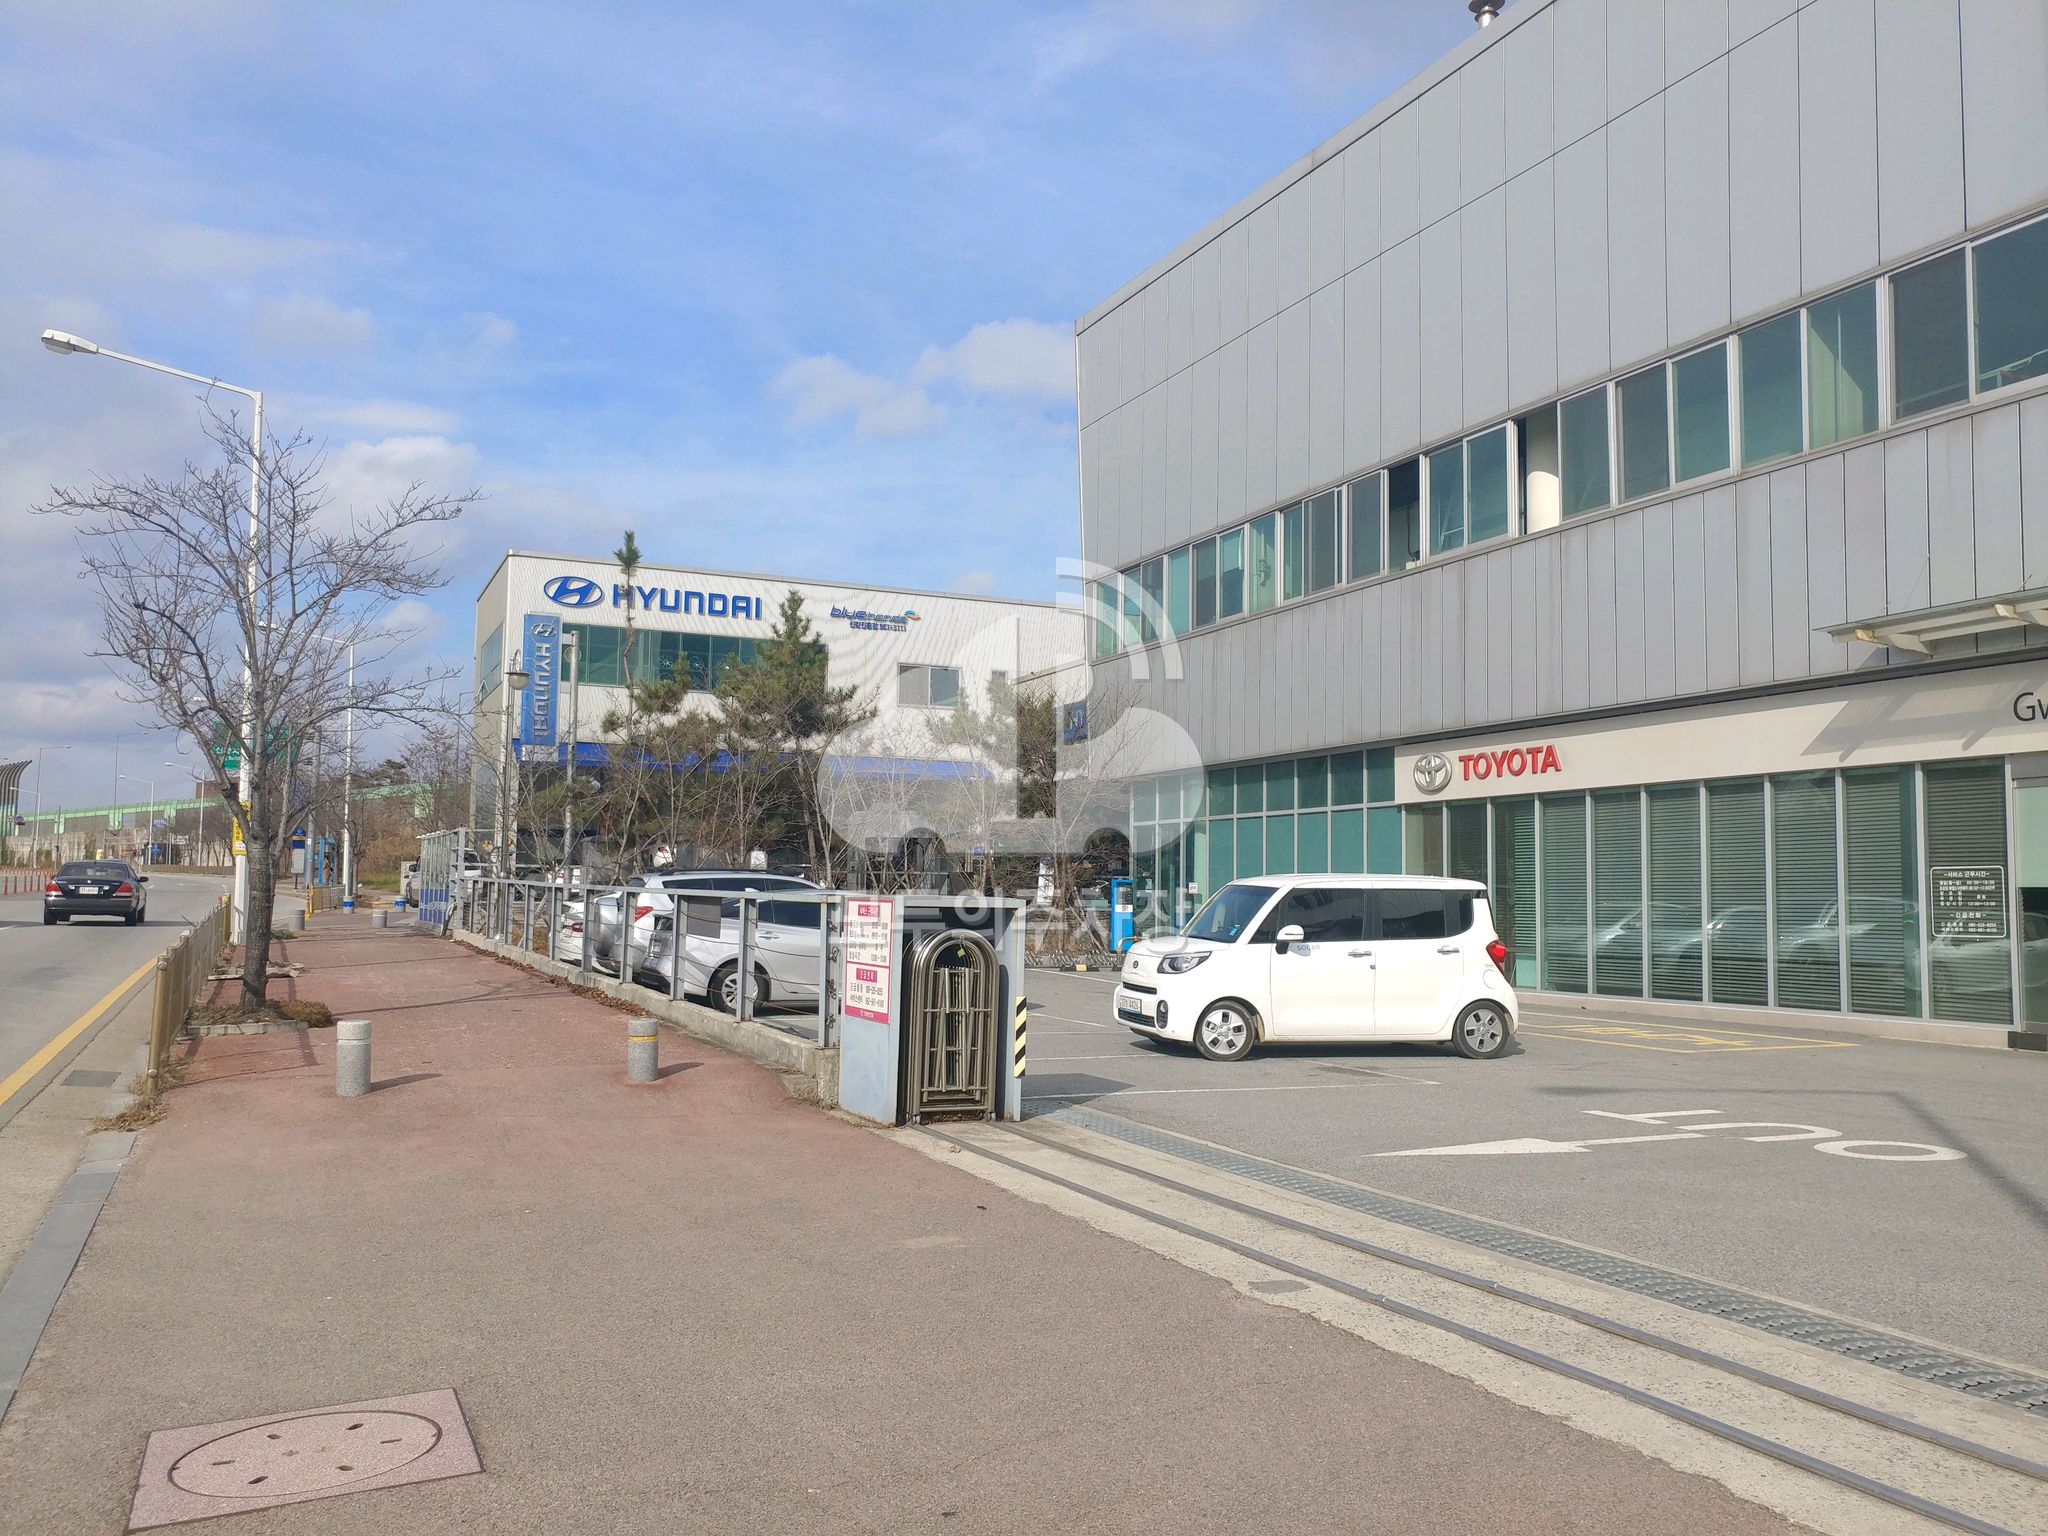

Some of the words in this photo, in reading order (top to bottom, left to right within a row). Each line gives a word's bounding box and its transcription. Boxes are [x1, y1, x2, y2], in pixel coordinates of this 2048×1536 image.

[612, 584, 762, 620] HYUNDAI
[534, 643, 551, 737] HYUNDAI
[1459, 744, 1562, 781] TOYOTA
